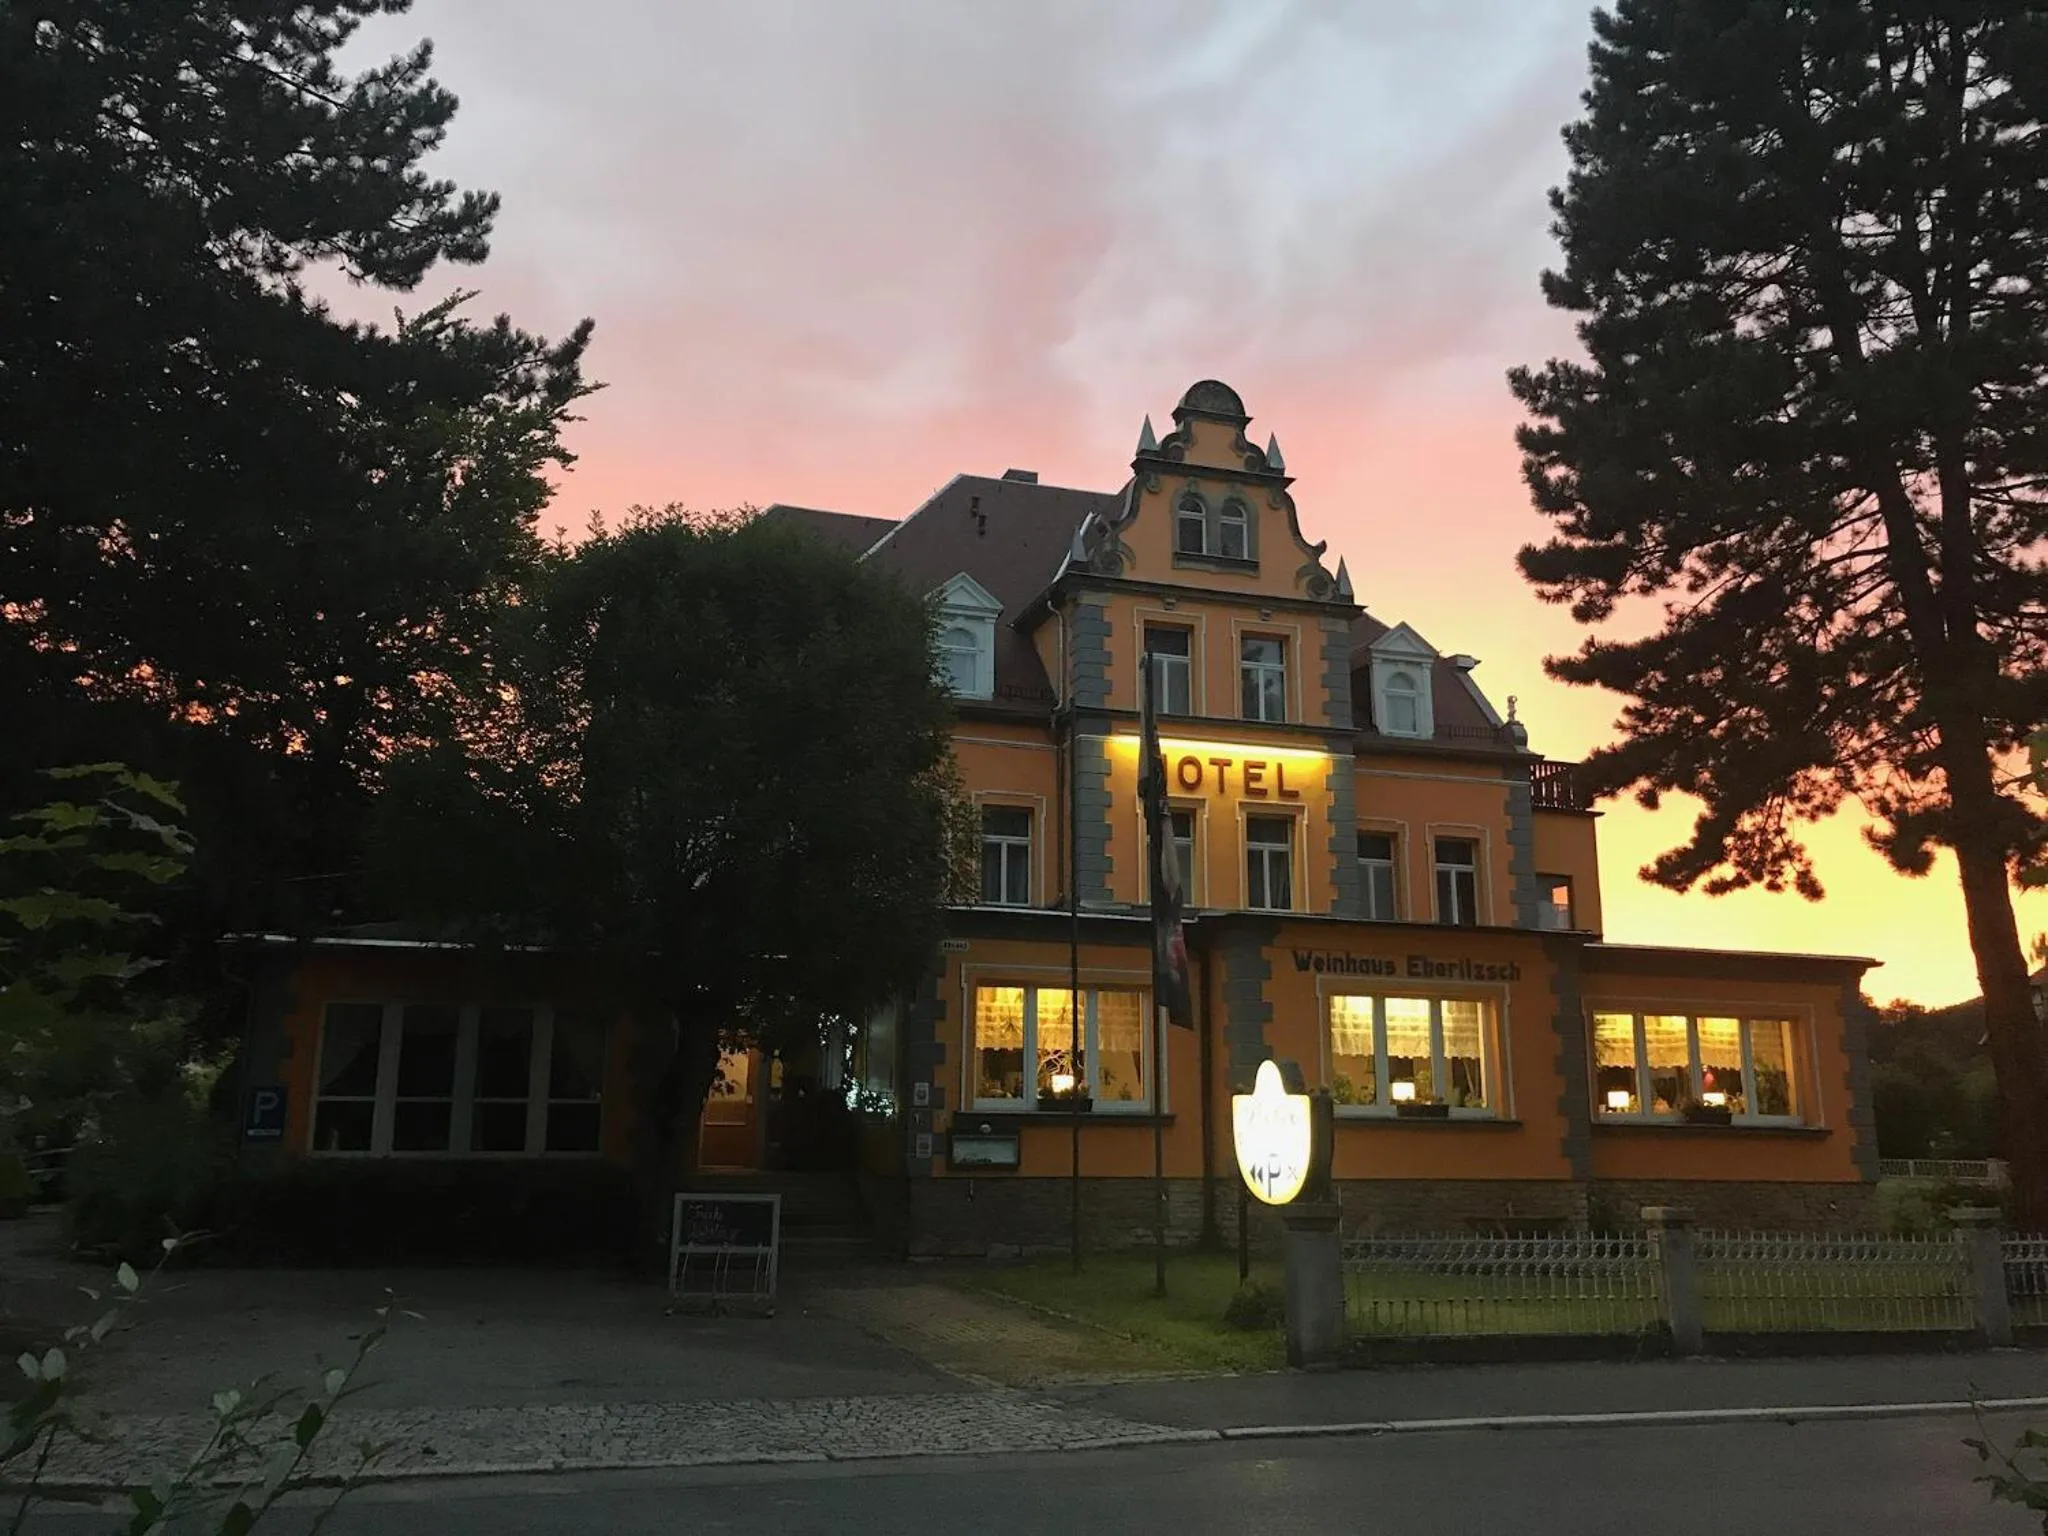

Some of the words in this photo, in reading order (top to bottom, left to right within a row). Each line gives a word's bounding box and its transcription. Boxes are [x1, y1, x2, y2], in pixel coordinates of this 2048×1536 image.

[1158, 754, 1300, 798] OTEL
[1292, 949, 1397, 976] Weinhaus
[253, 1091, 280, 1124] P
